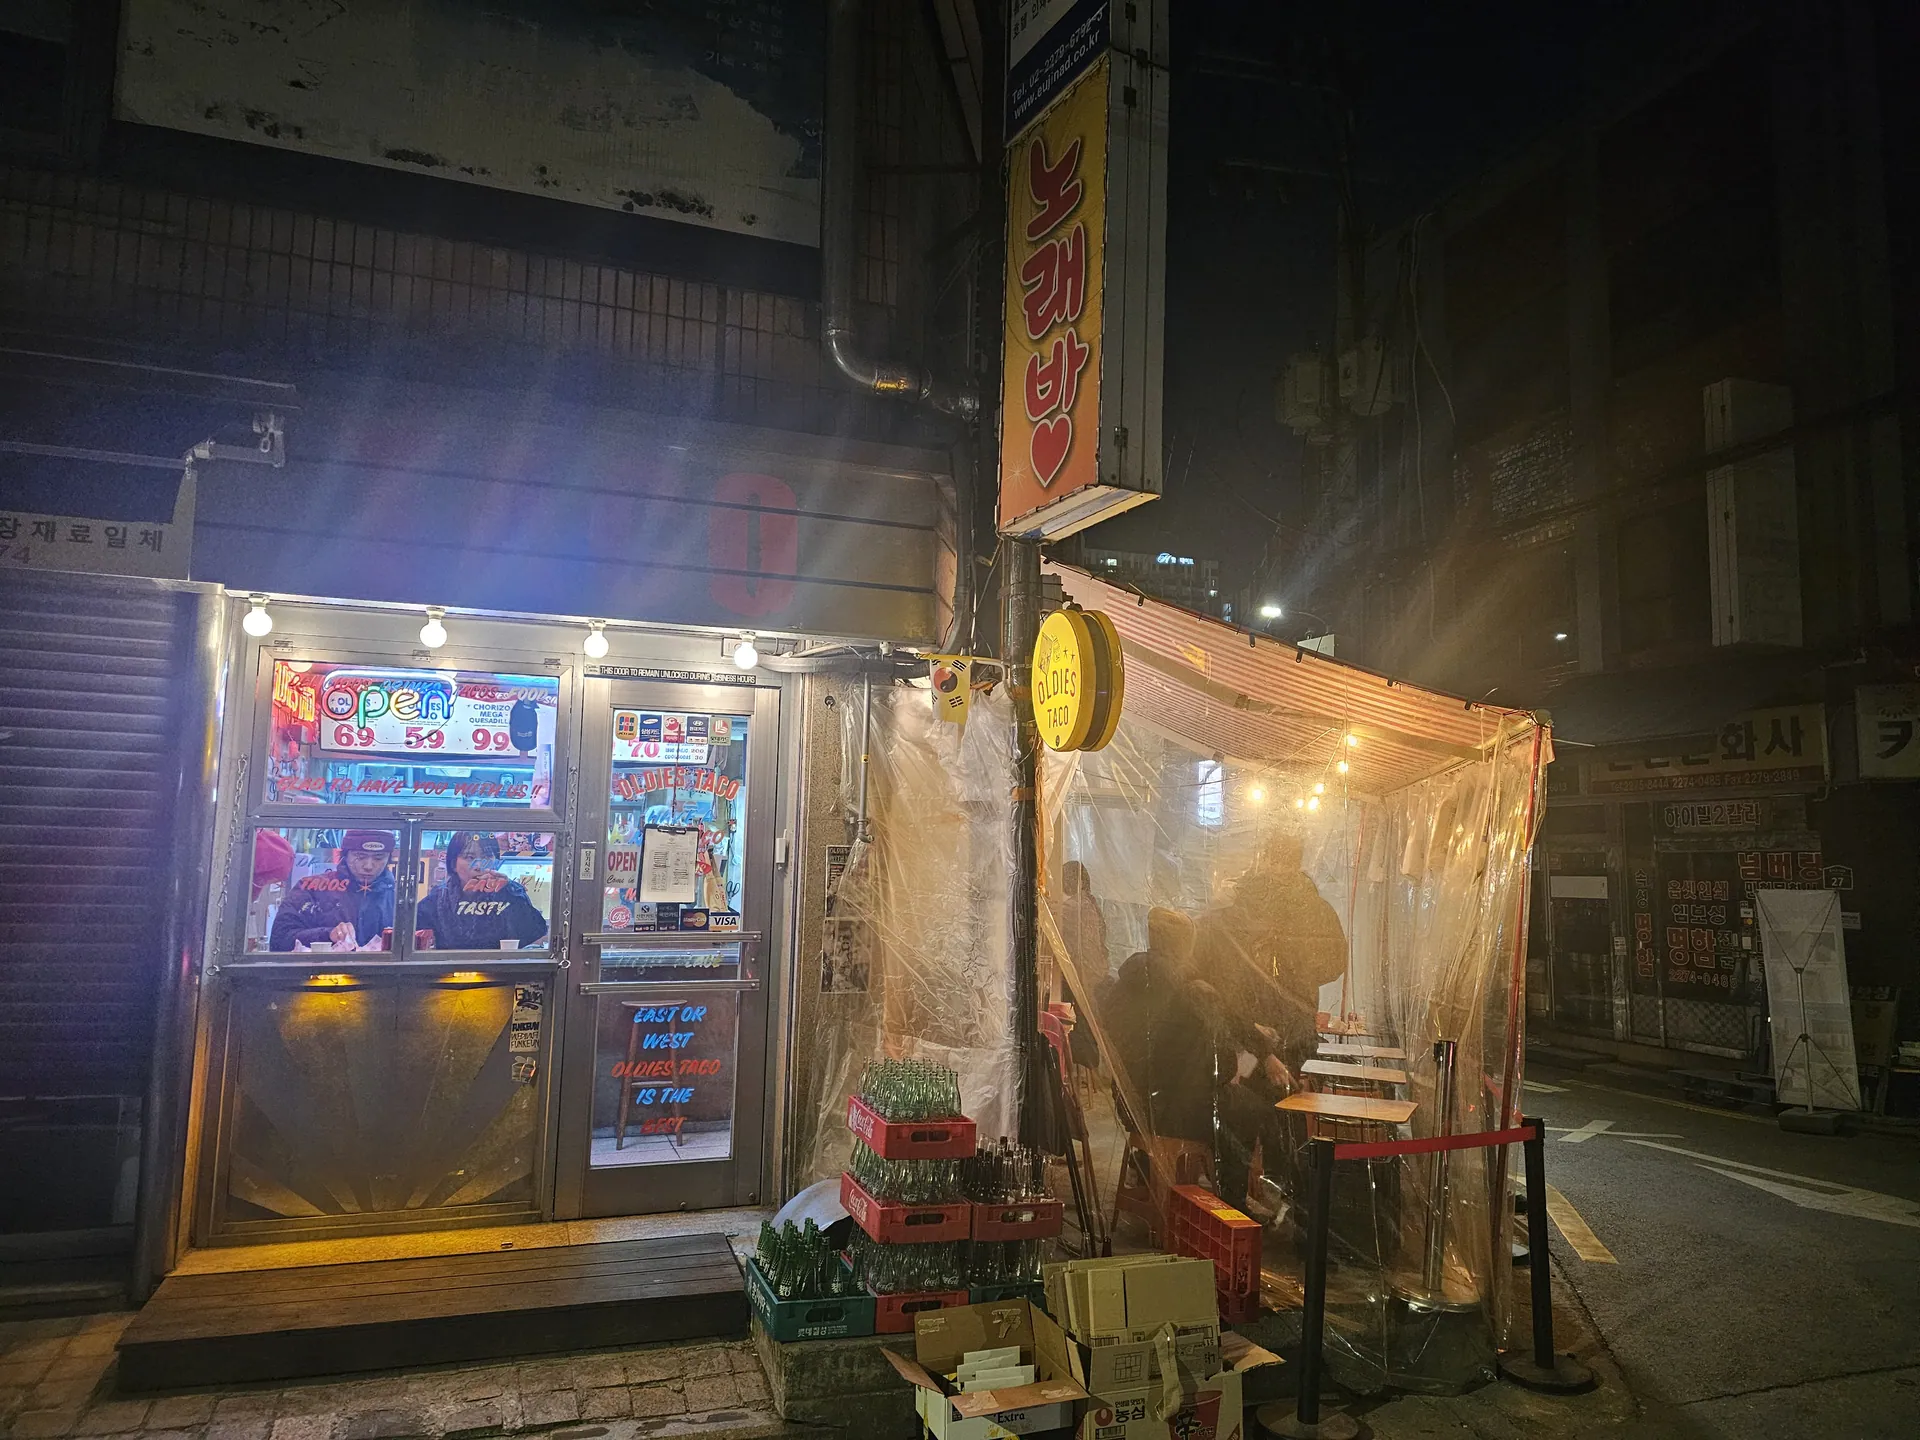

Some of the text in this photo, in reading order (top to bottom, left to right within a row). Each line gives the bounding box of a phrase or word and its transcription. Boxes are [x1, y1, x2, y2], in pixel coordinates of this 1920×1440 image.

[1014, 30, 1100, 119] www.eujinad.co.kr
[600, 667, 613, 675] THIS
[614, 668, 629, 676] DOOR
[630, 669, 638, 677] TO
[638, 669, 660, 678] REMAIN
[661, 671, 689, 679] UNLOCKED
[690, 672, 711, 681] DURING
[737, 675, 755, 684] HOURS
[1037, 668, 1077, 705] OLDIES
[1047, 705, 1069, 728] TACO
[276, 777, 326, 792] GLAD
[330, 778, 352, 793] TO
[357, 779, 407, 794] HAVE
[413, 781, 449, 796] YOU
[453, 782, 501, 797] WITH
[618, 765, 740, 800] OLDIES TACO
[608, 851, 638, 872] OPEN
[301, 878, 351, 892] TACOS
[1831, 877, 1844, 887] 27
[457, 901, 511, 916] TASTY
[714, 916, 737, 926] VISA
[1666, 927, 1717, 969] 명함
[633, 1006, 707, 1024] EAST OR
[642, 1032, 695, 1050] WEST
[611, 1059, 721, 1078] OLDIES TACO
[636, 1087, 695, 1105] IS THE
[640, 1116, 687, 1135] BEST
[997, 1411, 1025, 1424] Extra
[1115, 1405, 1146, 1424] 농심
